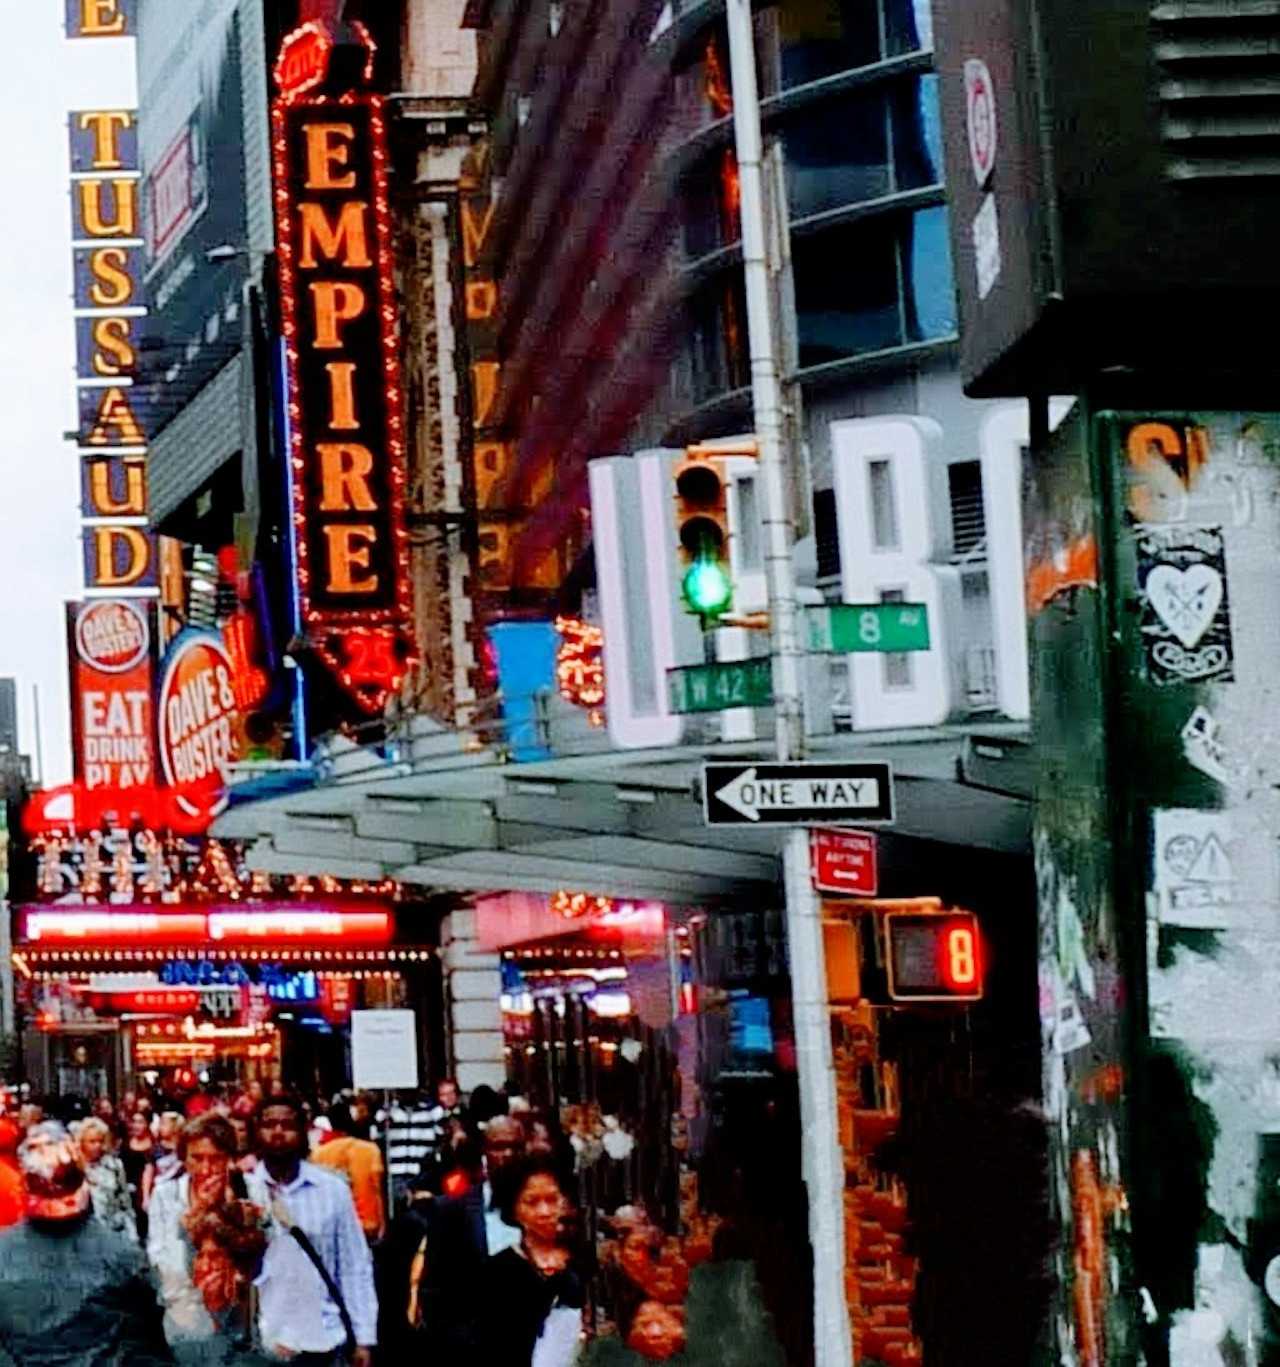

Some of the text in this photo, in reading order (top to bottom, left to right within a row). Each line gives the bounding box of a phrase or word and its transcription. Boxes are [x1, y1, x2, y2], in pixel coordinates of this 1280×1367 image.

[80, 111, 152, 586] TUSSAUD
[297, 121, 380, 594] EMPIRE
[858, 610, 881, 644] 8
[167, 663, 235, 746] DAVE &
[715, 672, 743, 703] 42
[83, 690, 149, 736] EAT
[84, 735, 149, 763] DRINK
[741, 782, 865, 806] ONE WAY
[949, 928, 975, 984] 8
